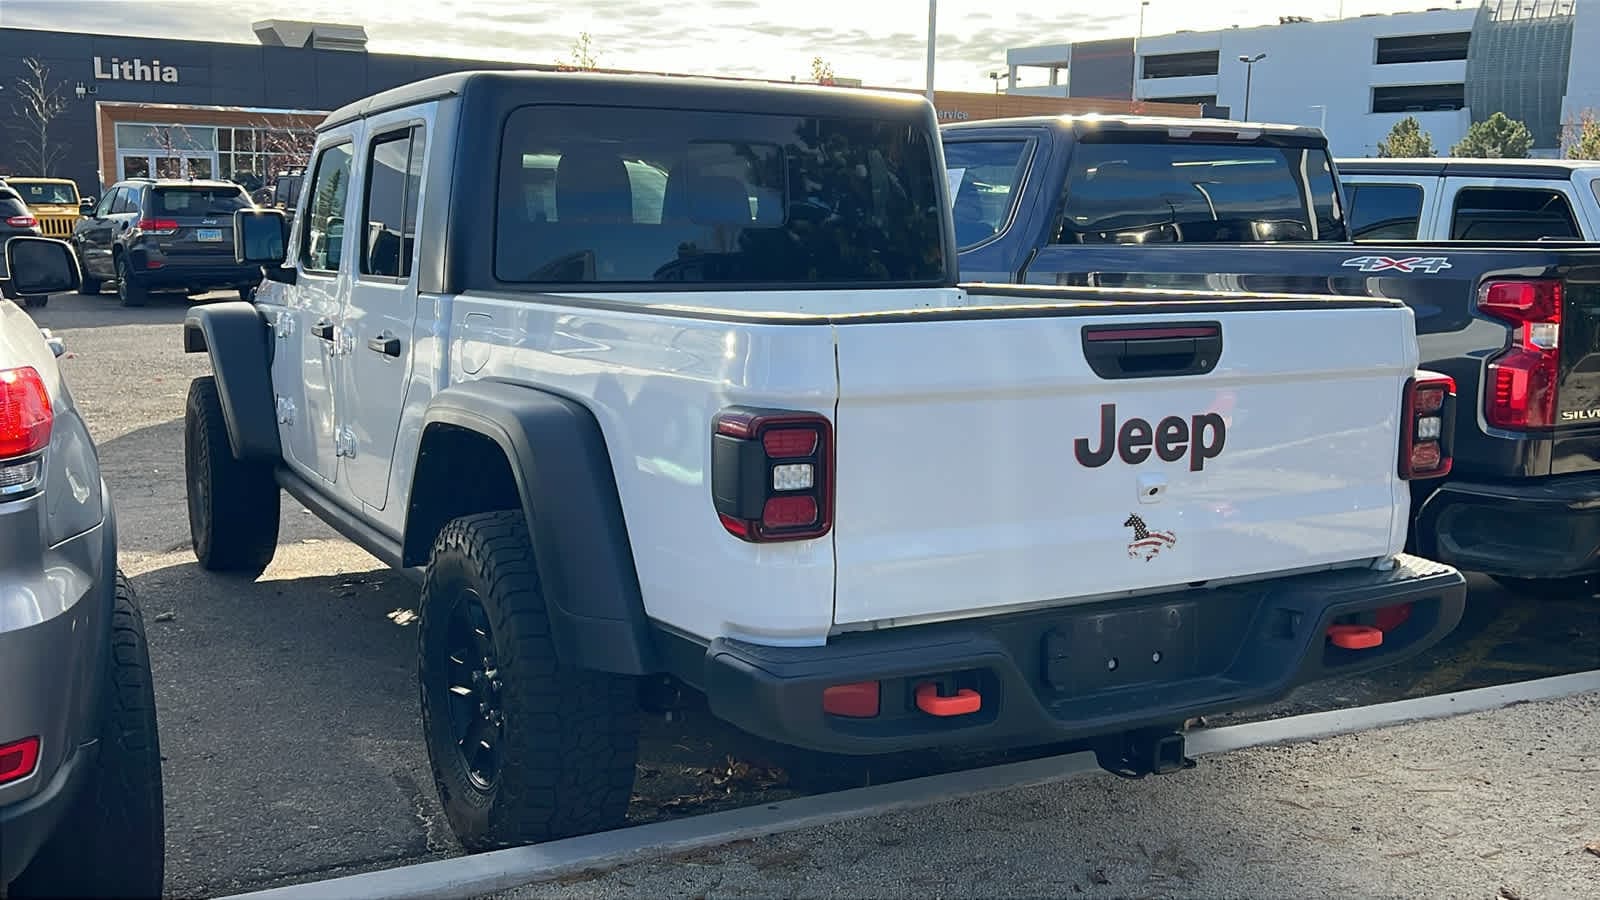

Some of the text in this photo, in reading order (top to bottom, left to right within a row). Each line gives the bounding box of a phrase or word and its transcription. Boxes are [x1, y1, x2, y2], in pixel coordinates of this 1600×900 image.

[94, 56, 178, 82] Lithia
[937, 110, 969, 120] ervice
[1074, 403, 1226, 472] Jeep
